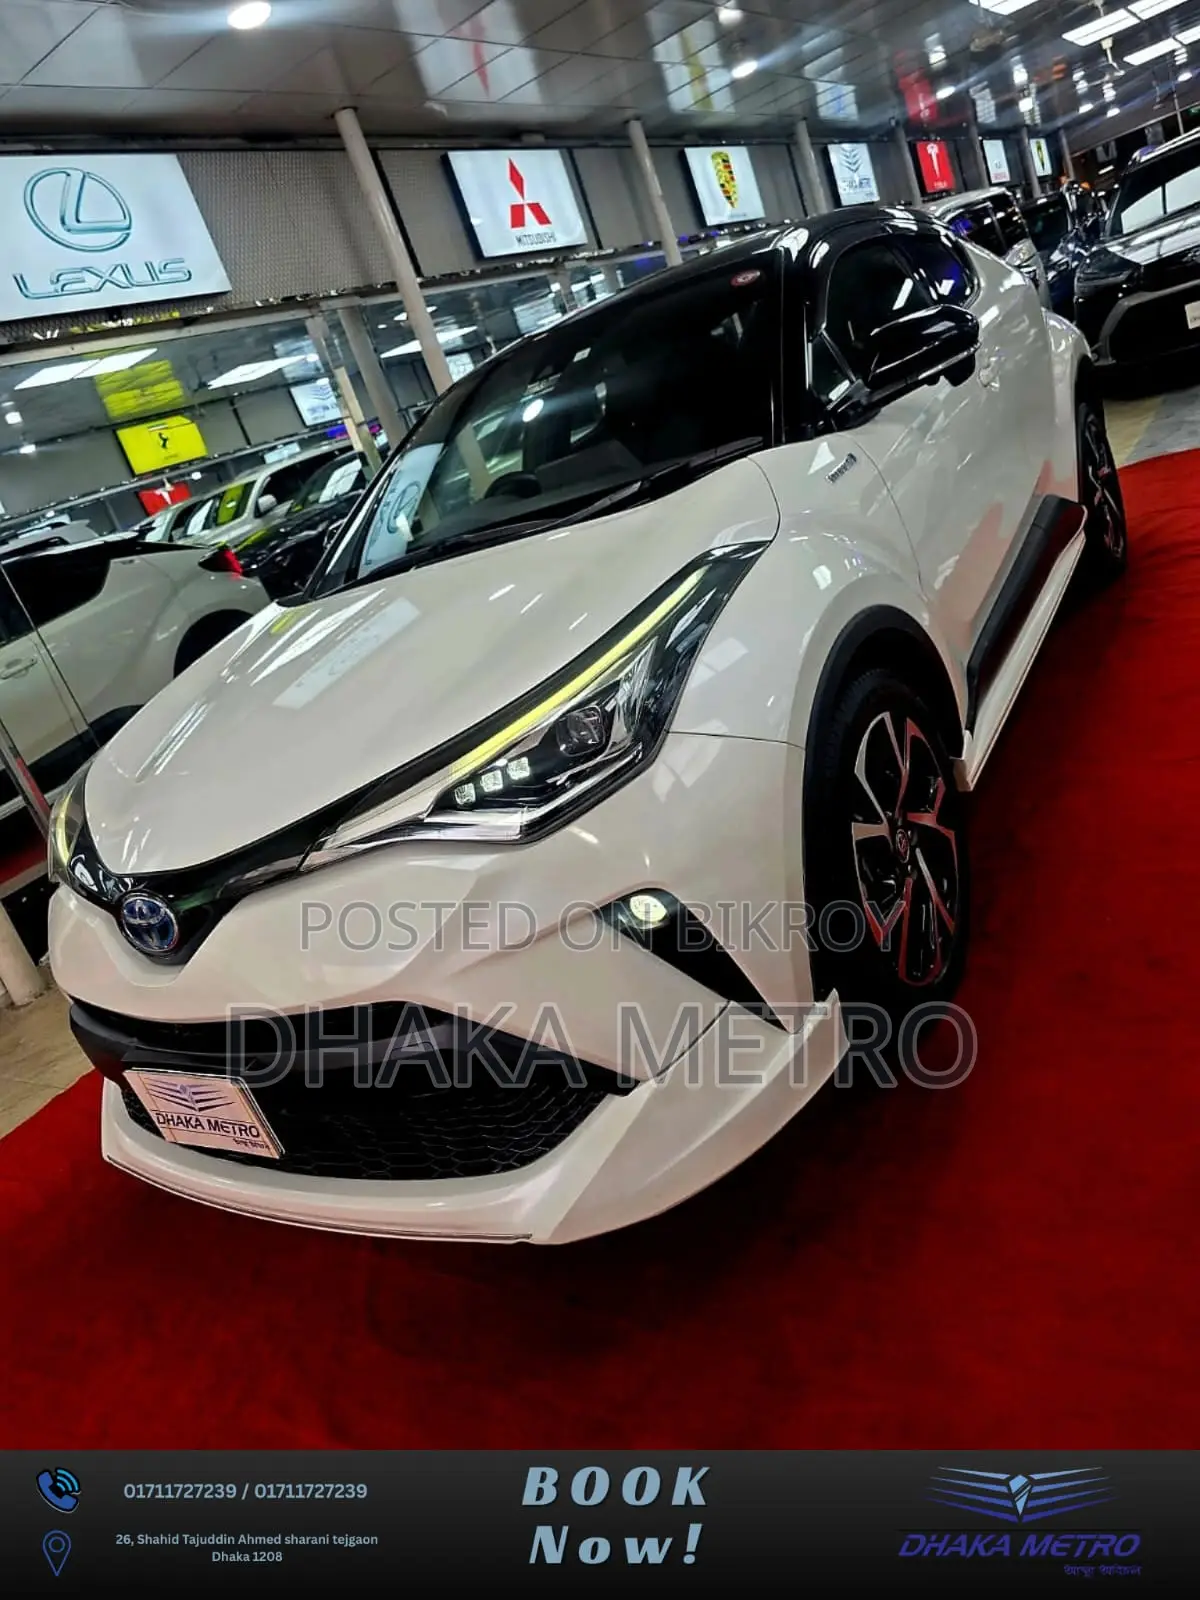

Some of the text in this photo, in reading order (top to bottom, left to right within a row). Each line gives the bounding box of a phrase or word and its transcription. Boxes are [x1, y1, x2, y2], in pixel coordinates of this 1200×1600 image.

[13, 257, 192, 300] LEXUS
[155, 1112, 260, 1138] DHAKA METRO
